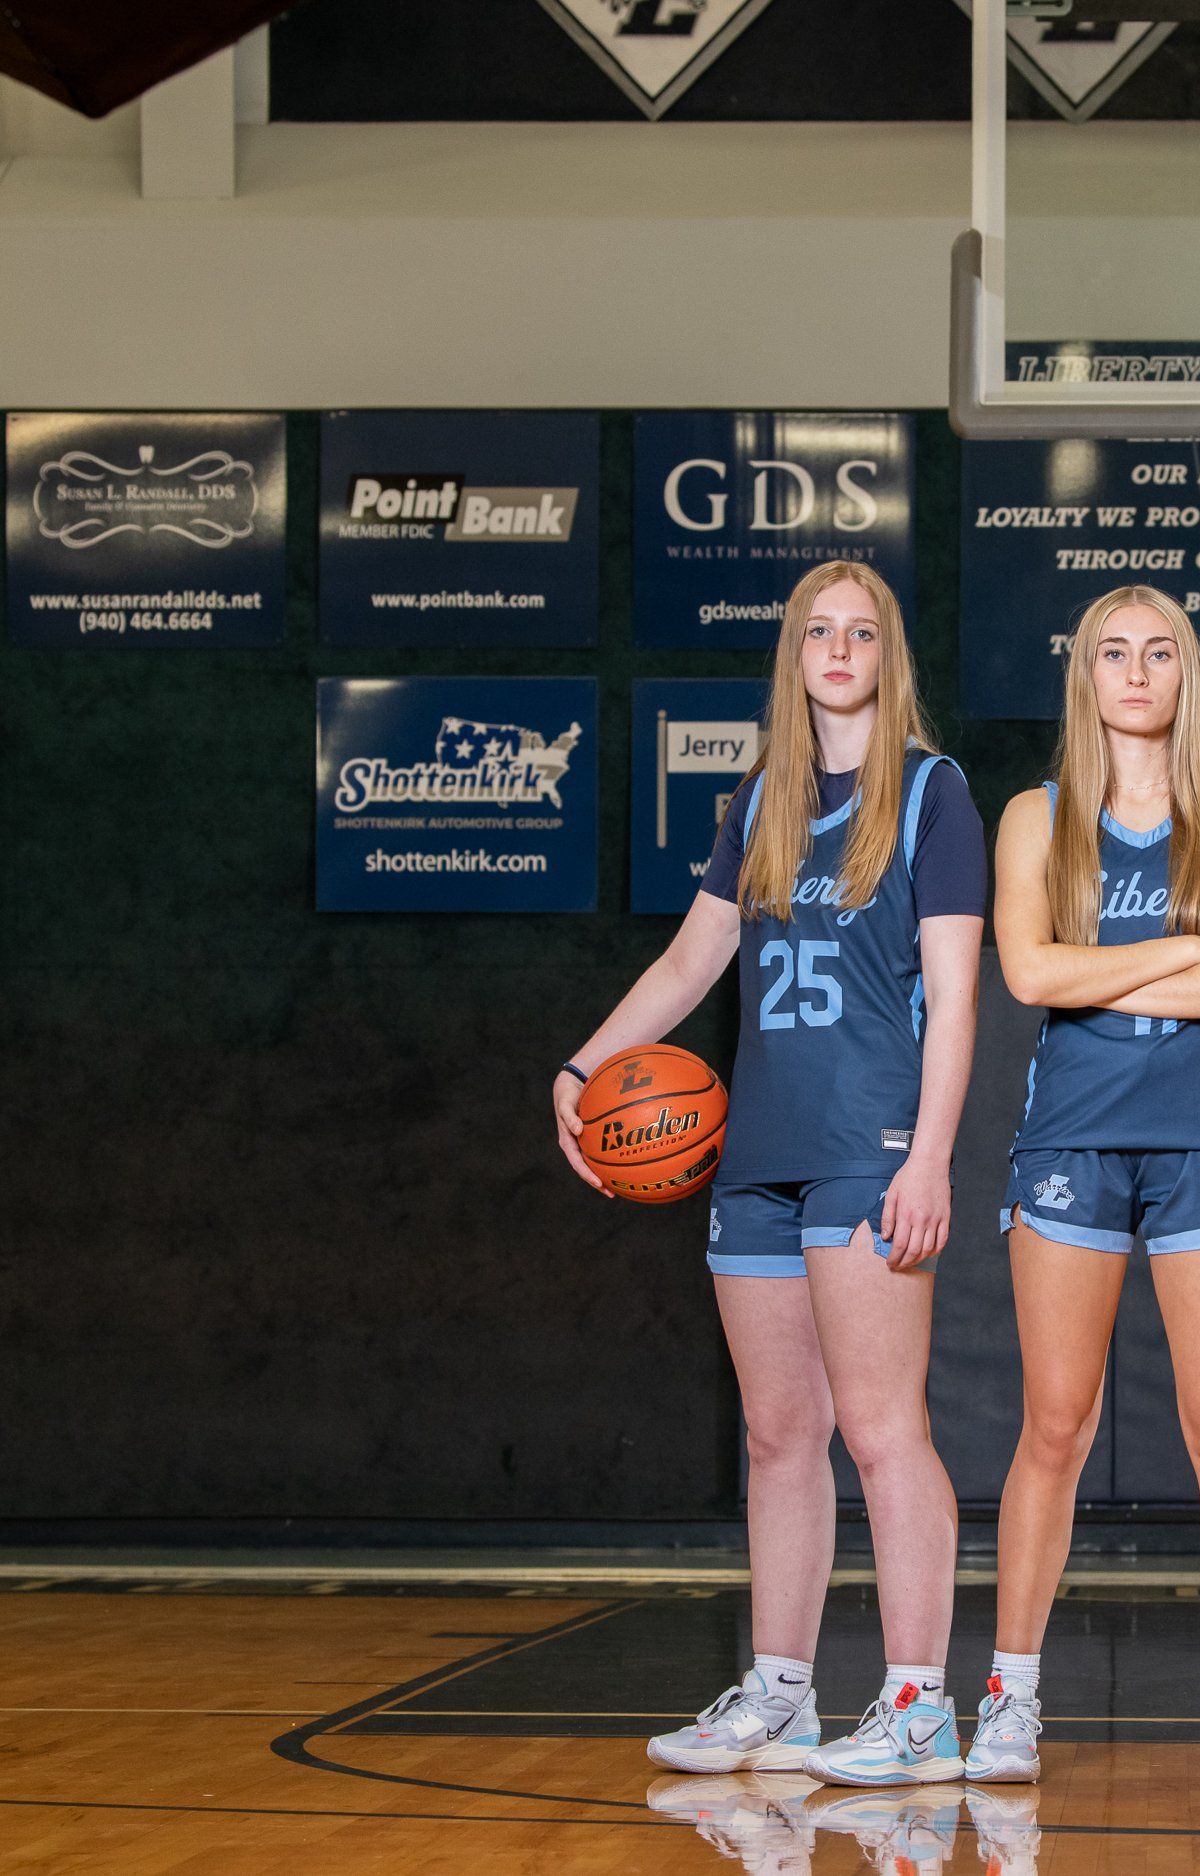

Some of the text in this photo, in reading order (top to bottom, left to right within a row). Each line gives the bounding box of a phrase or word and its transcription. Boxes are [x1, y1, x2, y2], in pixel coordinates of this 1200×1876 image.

[1132, 464, 1188, 485] OUR
[199, 484, 236, 500] DDS
[663, 458, 879, 532] GDS
[350, 478, 565, 535] Point Bank
[975, 507, 1091, 528] LOYALTY
[1096, 507, 1136, 528] WE
[339, 524, 434, 539] MEMBER FDIC
[667, 545, 875, 560] WEALTH MANAGEMENT
[1055, 550, 1185, 570] THROUGH
[30, 591, 263, 610] www.susanrandalldds.net
[371, 590, 546, 611] www.pointbank.com
[79, 611, 213, 634] (940) 464.6664
[678, 734, 745, 763] Jerry
[335, 758, 544, 812] Shottenkirk
[334, 817, 564, 830] SHOTTENKIRK AUTOMOTIVE GROUP
[364, 849, 548, 873] shottenkirk.com
[759, 939, 843, 1031] 25
[619, 1061, 653, 1095] L
[601, 1107, 701, 1152] Baden
[619, 1135, 684, 1158] PERFECTION
